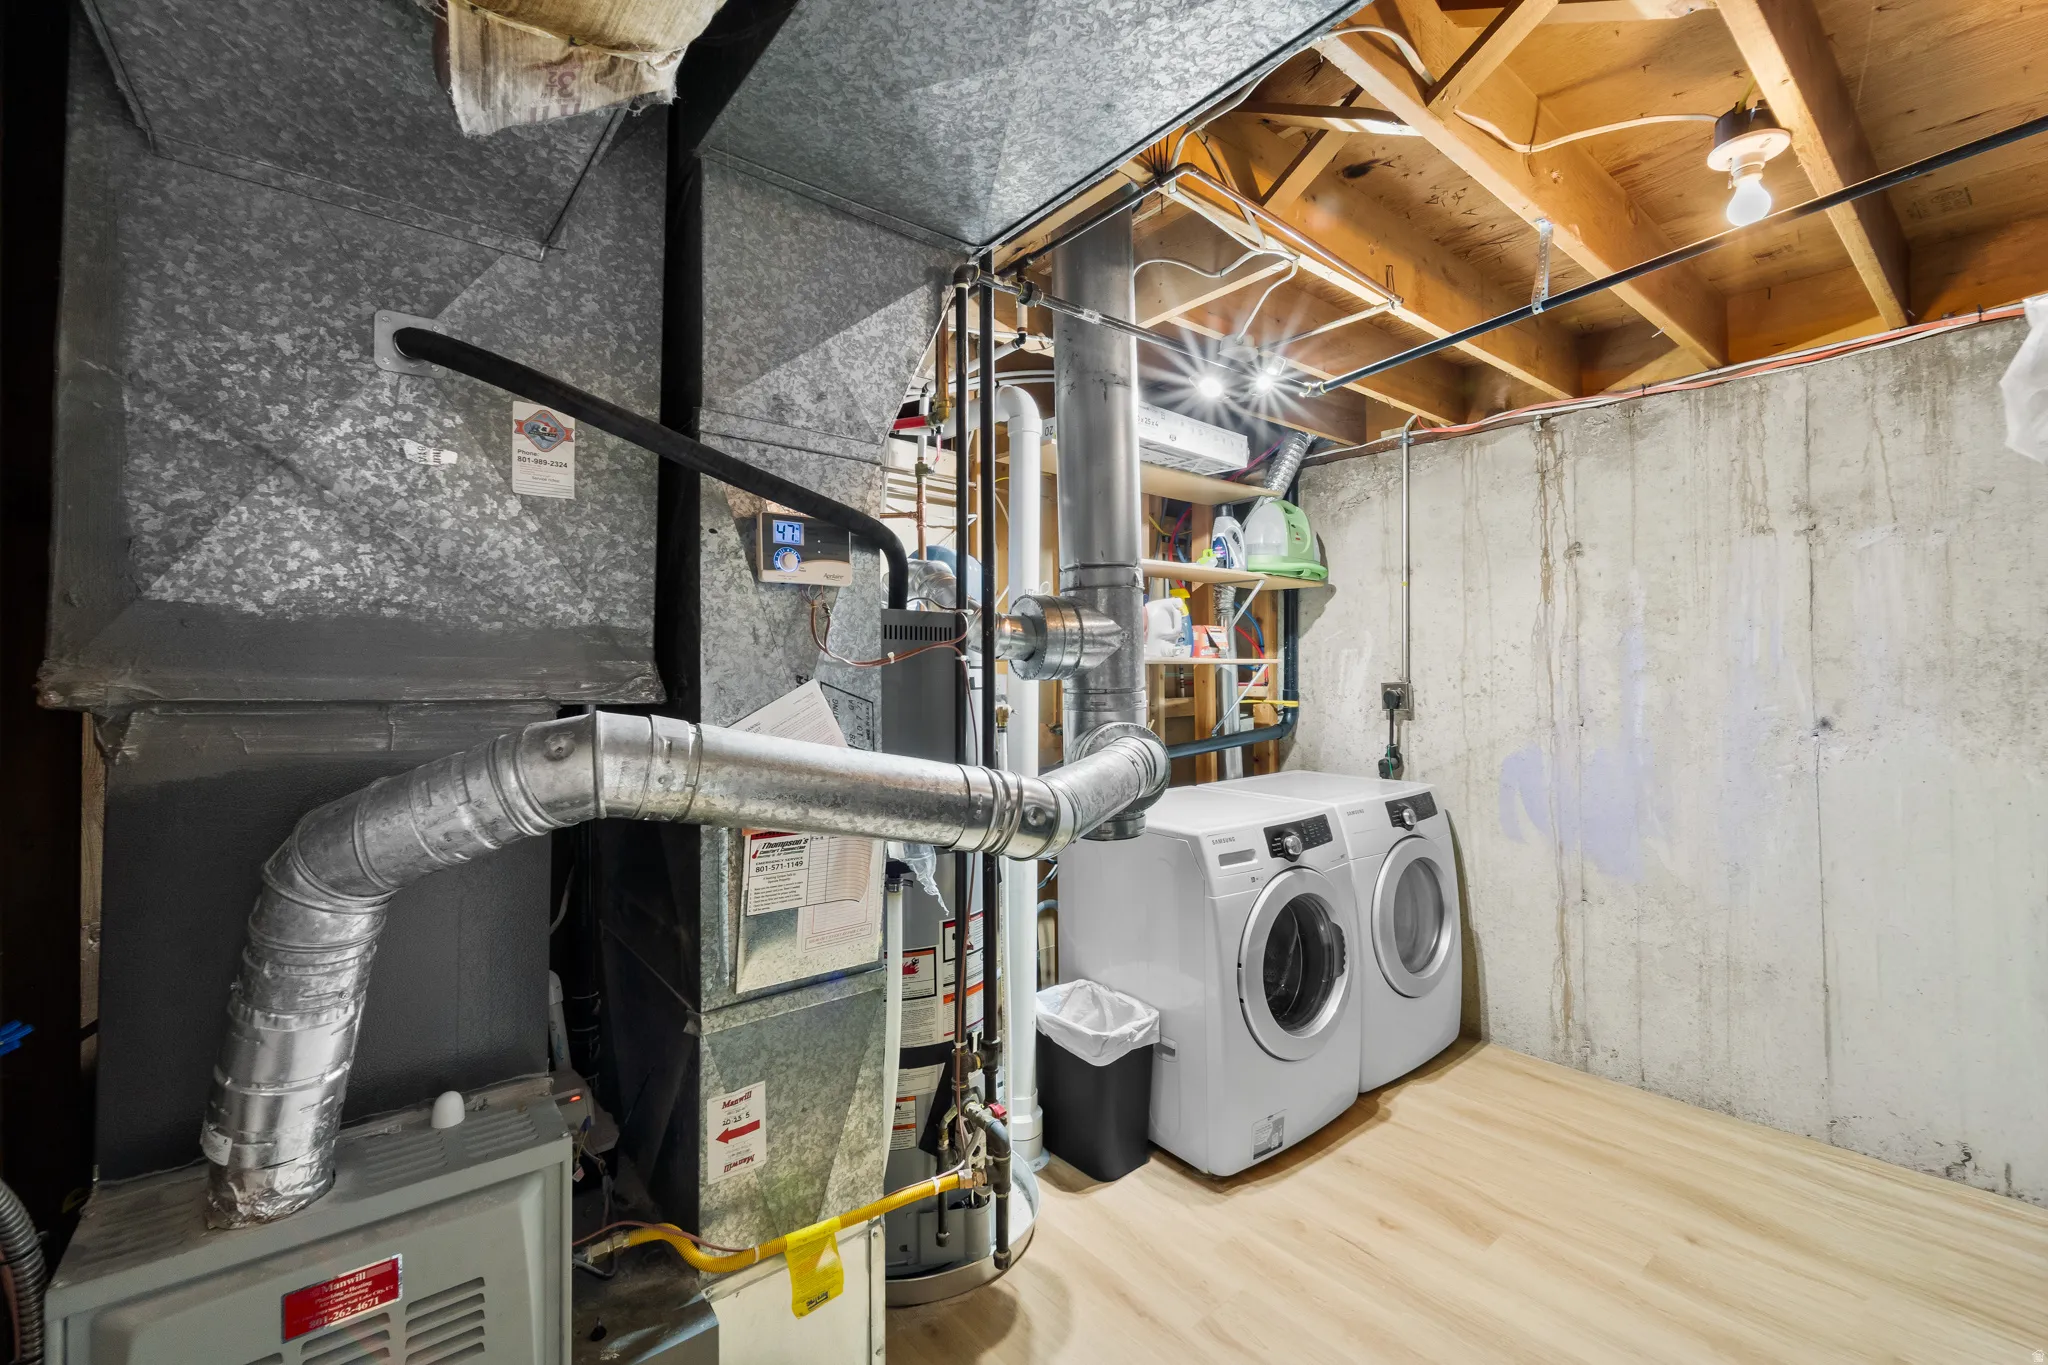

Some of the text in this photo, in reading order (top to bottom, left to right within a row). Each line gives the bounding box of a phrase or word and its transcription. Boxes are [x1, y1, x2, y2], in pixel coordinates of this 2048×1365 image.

[1045, 426, 1053, 436] 20
[517, 456, 567, 468] 801-989-2324
[776, 524, 795, 541] 47
[1347, 808, 1364, 816] SAMSUNG
[762, 838, 809, 849] Thompson's
[1212, 836, 1235, 846] SAMSUNG
[756, 861, 803, 872] 801-571-1149
[722, 1091, 752, 1110] Manwill
[724, 1154, 755, 1173] Manwill
[321, 1272, 366, 1294] Manwill
[349, 1281, 373, 1292] Heating
[330, 1287, 369, 1305] Conditioning
[309, 1296, 379, 1329] 801-262-4671
